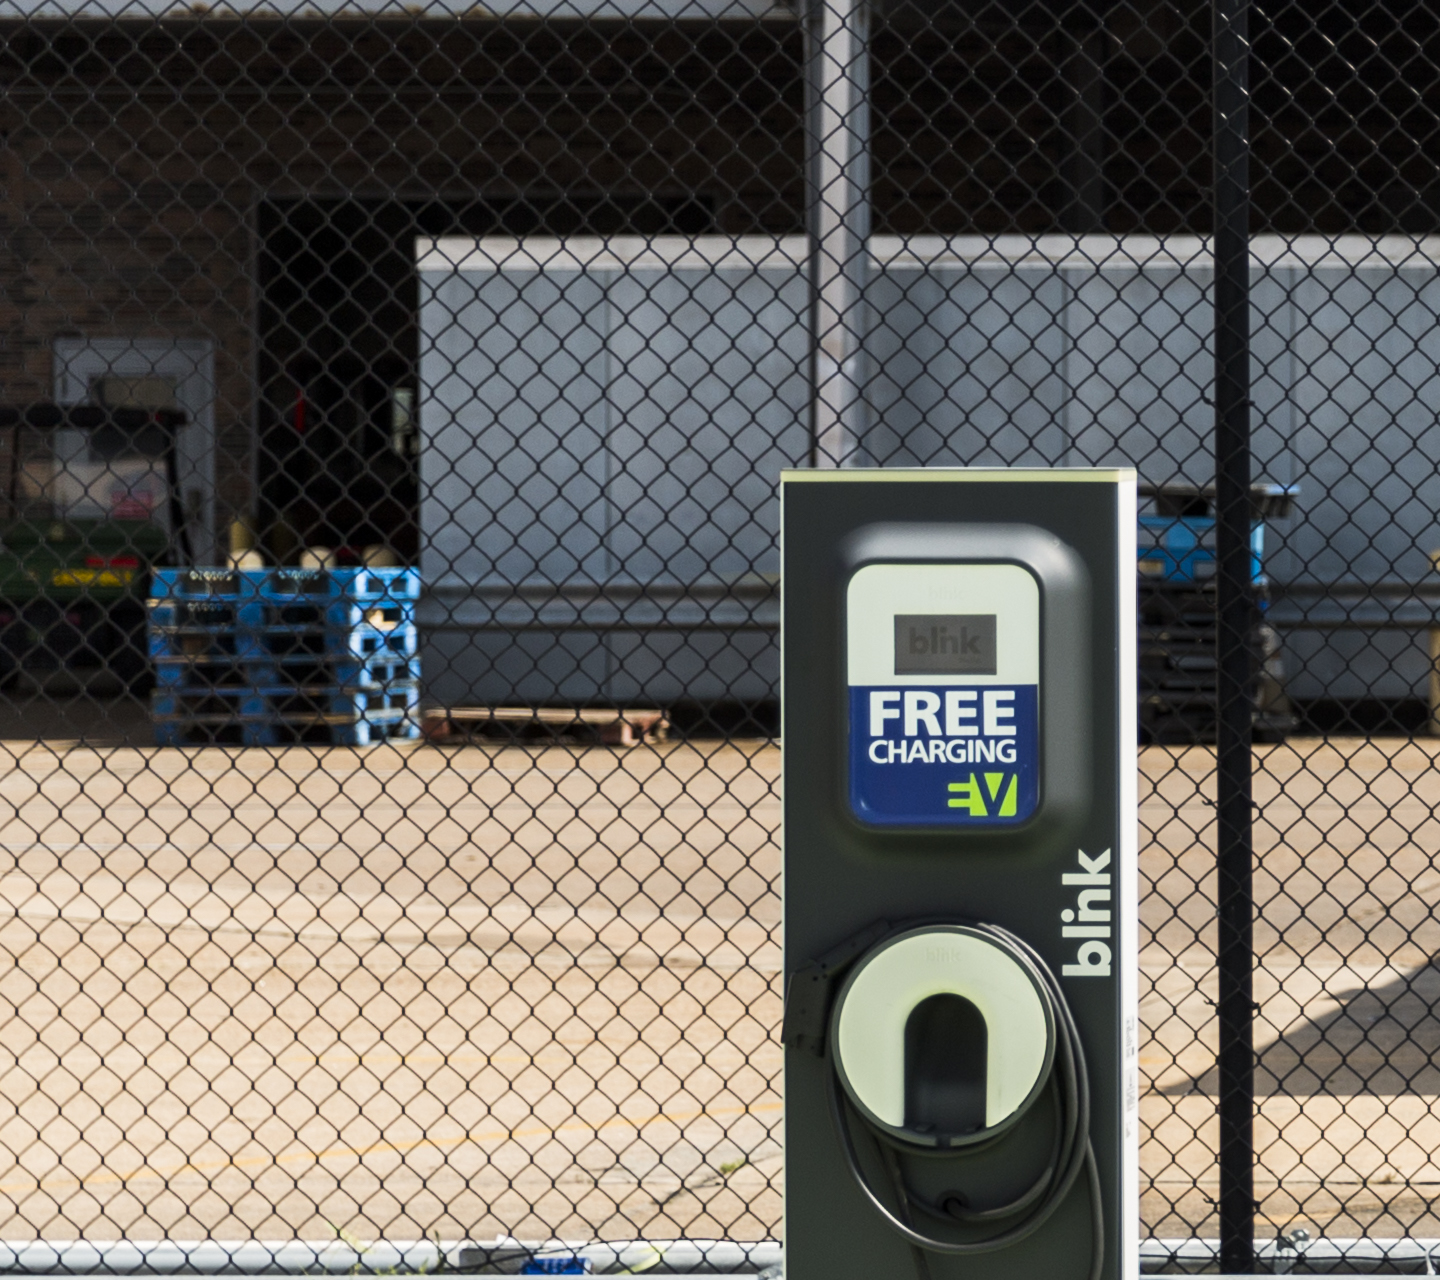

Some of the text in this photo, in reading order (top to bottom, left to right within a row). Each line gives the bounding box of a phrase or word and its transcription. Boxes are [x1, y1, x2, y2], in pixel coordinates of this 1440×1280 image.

[909, 626, 981, 655] blink
[869, 690, 1017, 737] FREE
[868, 738, 1017, 764] CHARGING
[947, 772, 1018, 817] EV
[1060, 847, 1112, 977] blink
[925, 947, 962, 962] blink
